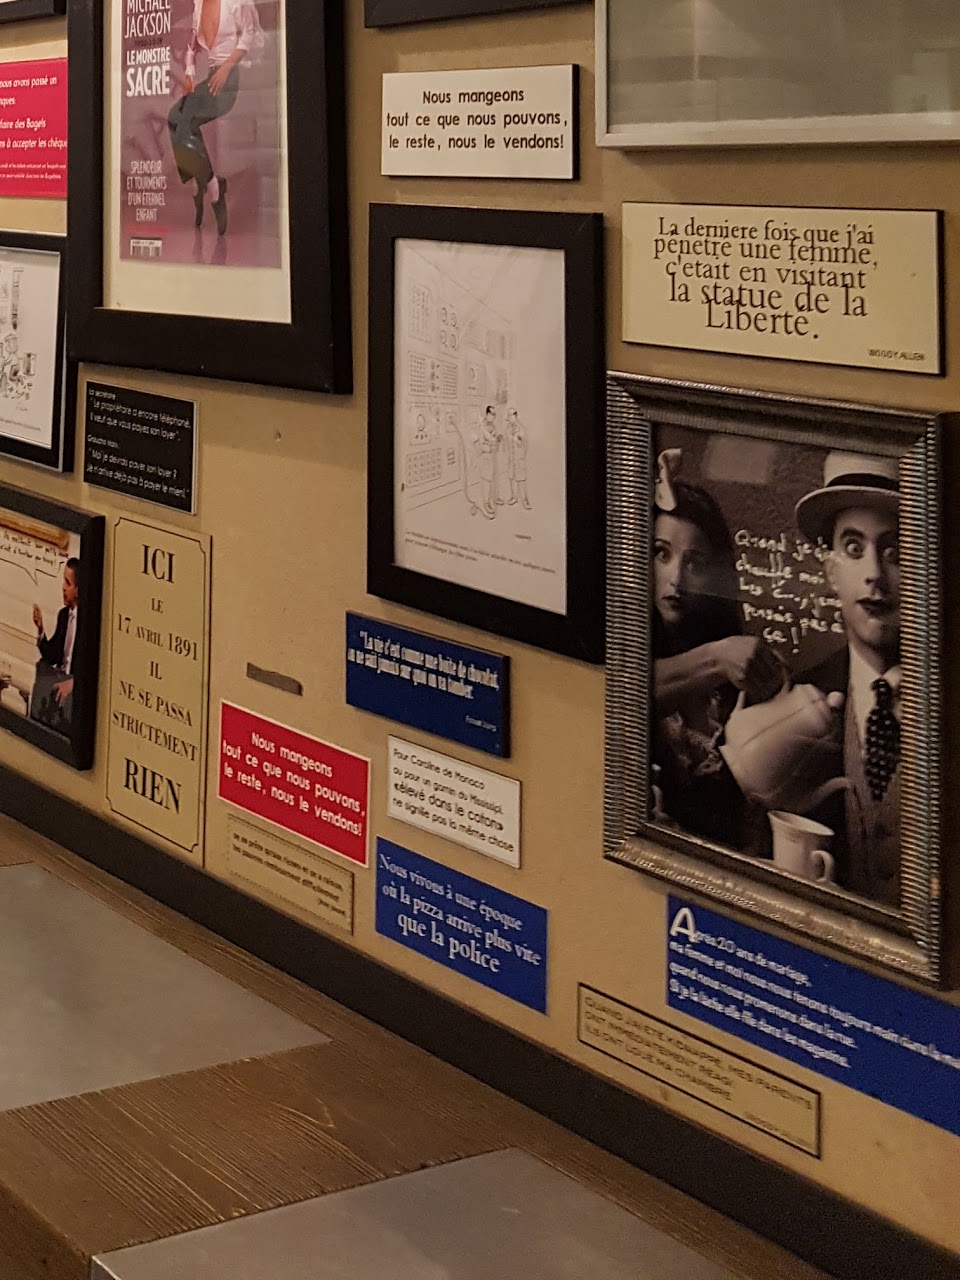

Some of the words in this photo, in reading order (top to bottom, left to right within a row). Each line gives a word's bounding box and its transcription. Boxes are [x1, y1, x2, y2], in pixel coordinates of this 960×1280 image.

[124, 10, 171, 40] JACKSON
[126, 50, 136, 66] LE
[136, 45, 171, 65] MONSTRE
[422, 91, 451, 104] Nous
[458, 90, 524, 106] mangeons
[386, 112, 409, 127] tout
[415, 115, 430, 126] ce
[437, 114, 460, 130] que
[467, 113, 496, 126] nous
[503, 111, 568, 128] pouvons,
[389, 134, 399, 149] le
[405, 134, 441, 151] reste,
[448, 134, 477, 149] nous
[484, 133, 495, 149] le
[503, 133, 564, 149] vendons!
[130, 160, 163, 175] SPLENDEUR
[658, 216, 679, 236] La
[763, 220, 797, 241] fois
[804, 228, 839, 250] que
[846, 224, 874, 248] j'ai
[739, 239, 781, 260] une
[789, 236, 878, 269] femme,
[669, 272, 690, 302] la
[701, 283, 783, 310] statue
[794, 281, 829, 314] de
[842, 284, 868, 317] la
[739, 265, 766, 283] en
[776, 260, 866, 289] visitant
[141, 544, 175, 584] ICI
[151, 598, 164, 614] LE
[117, 613, 132, 634] 17
[136, 626, 164, 647] AVRIL
[167, 632, 198, 661] 1891
[150, 661, 162, 680] IL
[119, 680, 135, 701] NE
[138, 689, 153, 708] SE
[155, 695, 193, 727] PASSA
[112, 709, 198, 762] STRICTEMENT
[252, 732, 275, 753] Nous
[280, 746, 333, 777] mangeons
[123, 757, 182, 815] RIEN
[223, 740, 241, 760] tout
[245, 753, 258, 768] ce
[263, 760, 282, 778] que
[286, 770, 310, 791] nous
[315, 783, 366, 817] pouvons,
[224, 762, 233, 778] le
[237, 770, 266, 795] reste,
[271, 786, 294, 806] nous
[299, 795, 309, 812] le
[314, 805, 363, 837] vendons!
[379, 854, 407, 879] Nous
[410, 869, 444, 896] vivons
[446, 884, 453, 900] à
[456, 891, 477, 910] une
[479, 899, 522, 931] époque
[382, 881, 397, 898] où
[400, 885, 411, 905] la
[413, 896, 444, 921] pizza
[446, 911, 483, 938] arrive
[485, 928, 513, 953] plus
[514, 943, 541, 965] vite
[397, 913, 427, 937] que
[431, 920, 445, 947] la
[449, 936, 501, 973] police
